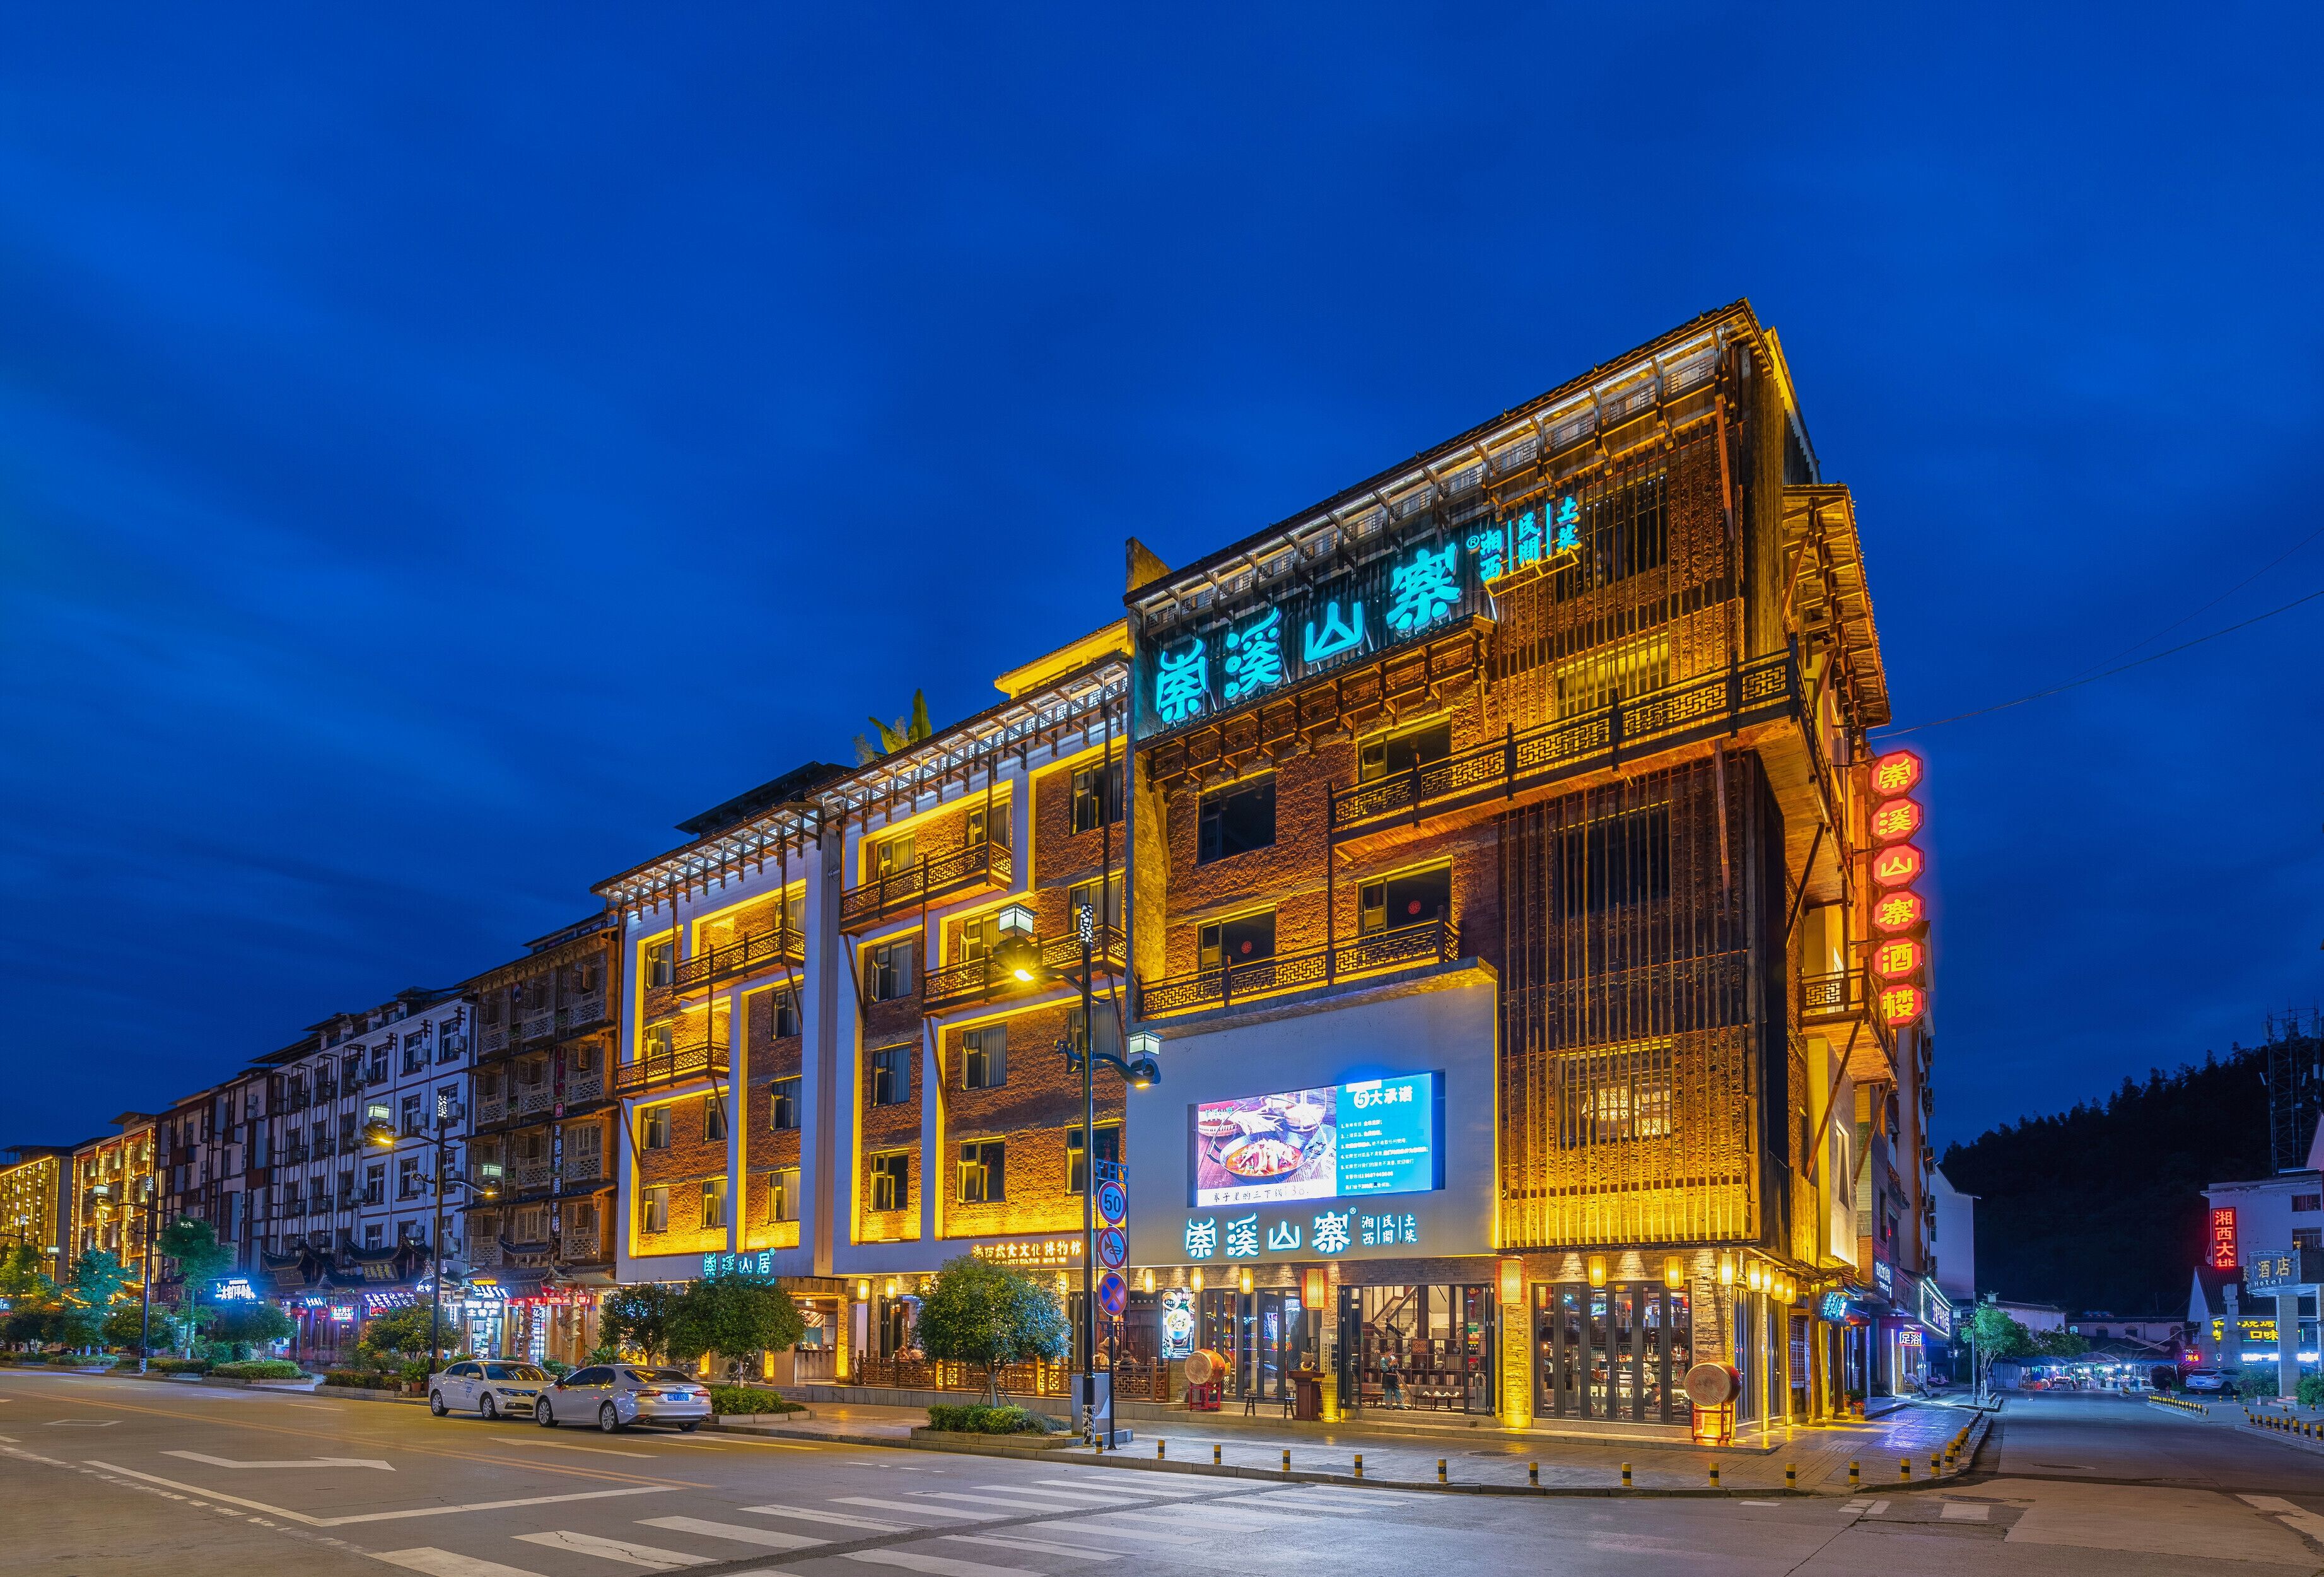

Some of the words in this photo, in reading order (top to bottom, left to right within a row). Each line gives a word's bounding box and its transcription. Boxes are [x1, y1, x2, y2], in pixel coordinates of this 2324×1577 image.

[1104, 1194, 1121, 1213] 50
[1362, 1216, 1374, 1245] 湘西
[2258, 1257, 2291, 1278] 酒店
[2254, 1277, 2282, 1287] Hotel
[1901, 1334, 1921, 1345] 足浴
